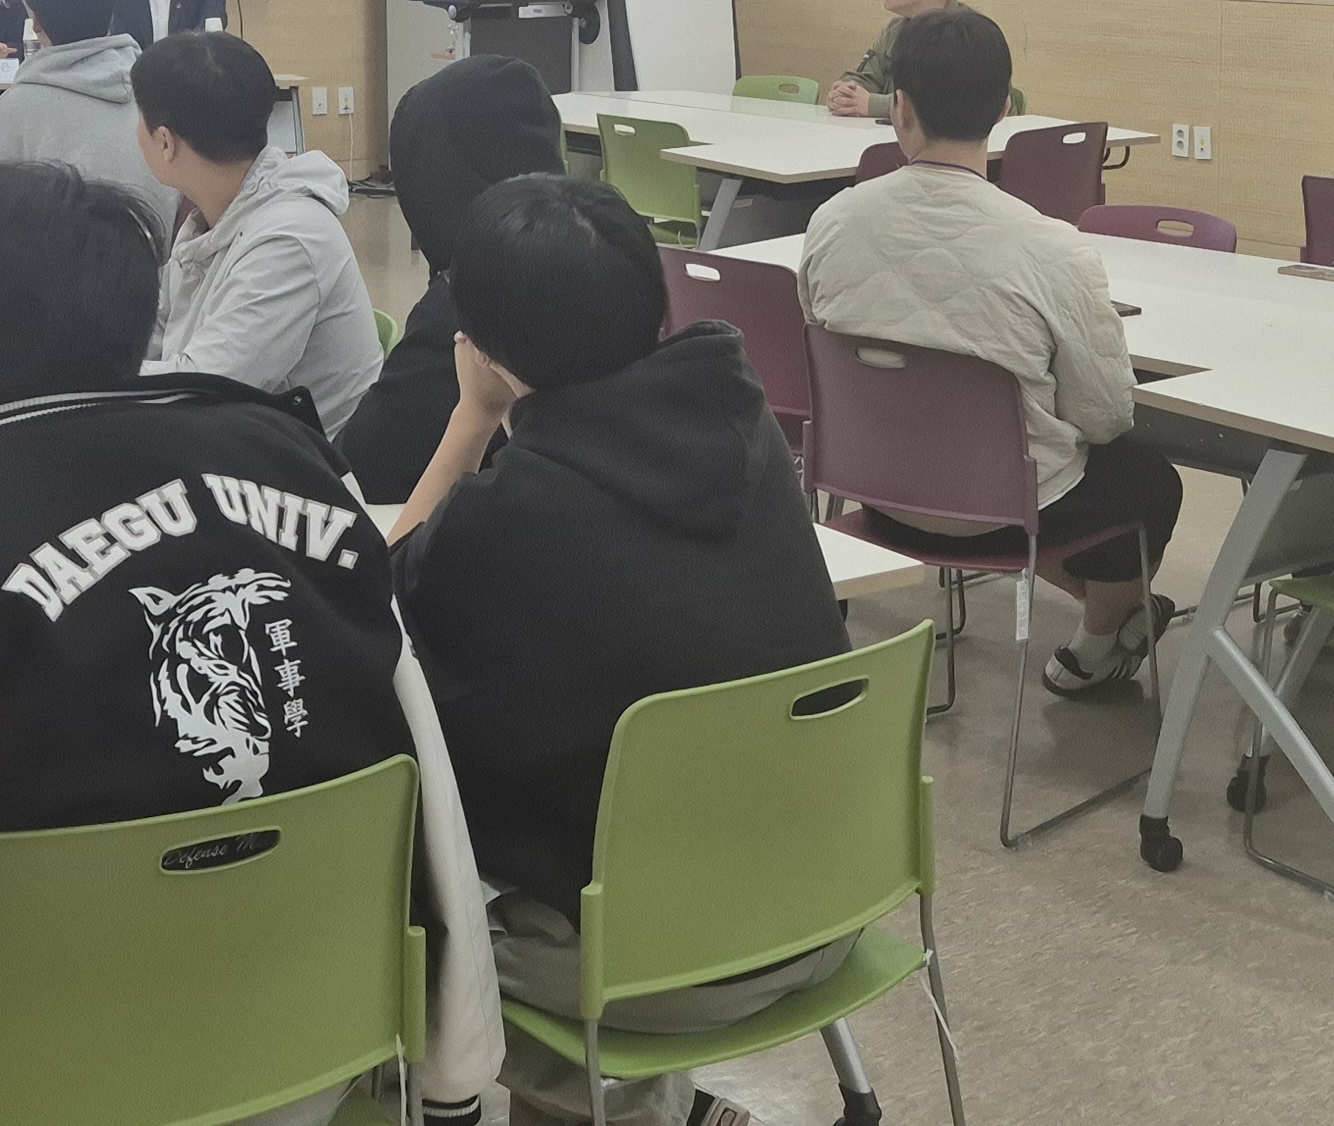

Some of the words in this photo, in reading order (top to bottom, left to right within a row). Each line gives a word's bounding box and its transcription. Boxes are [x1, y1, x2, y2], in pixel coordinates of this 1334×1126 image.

[1, 478, 198, 622] DAEGU
[200, 473, 359, 571] UNIV.
[264, 618, 309, 739] 軍事學
